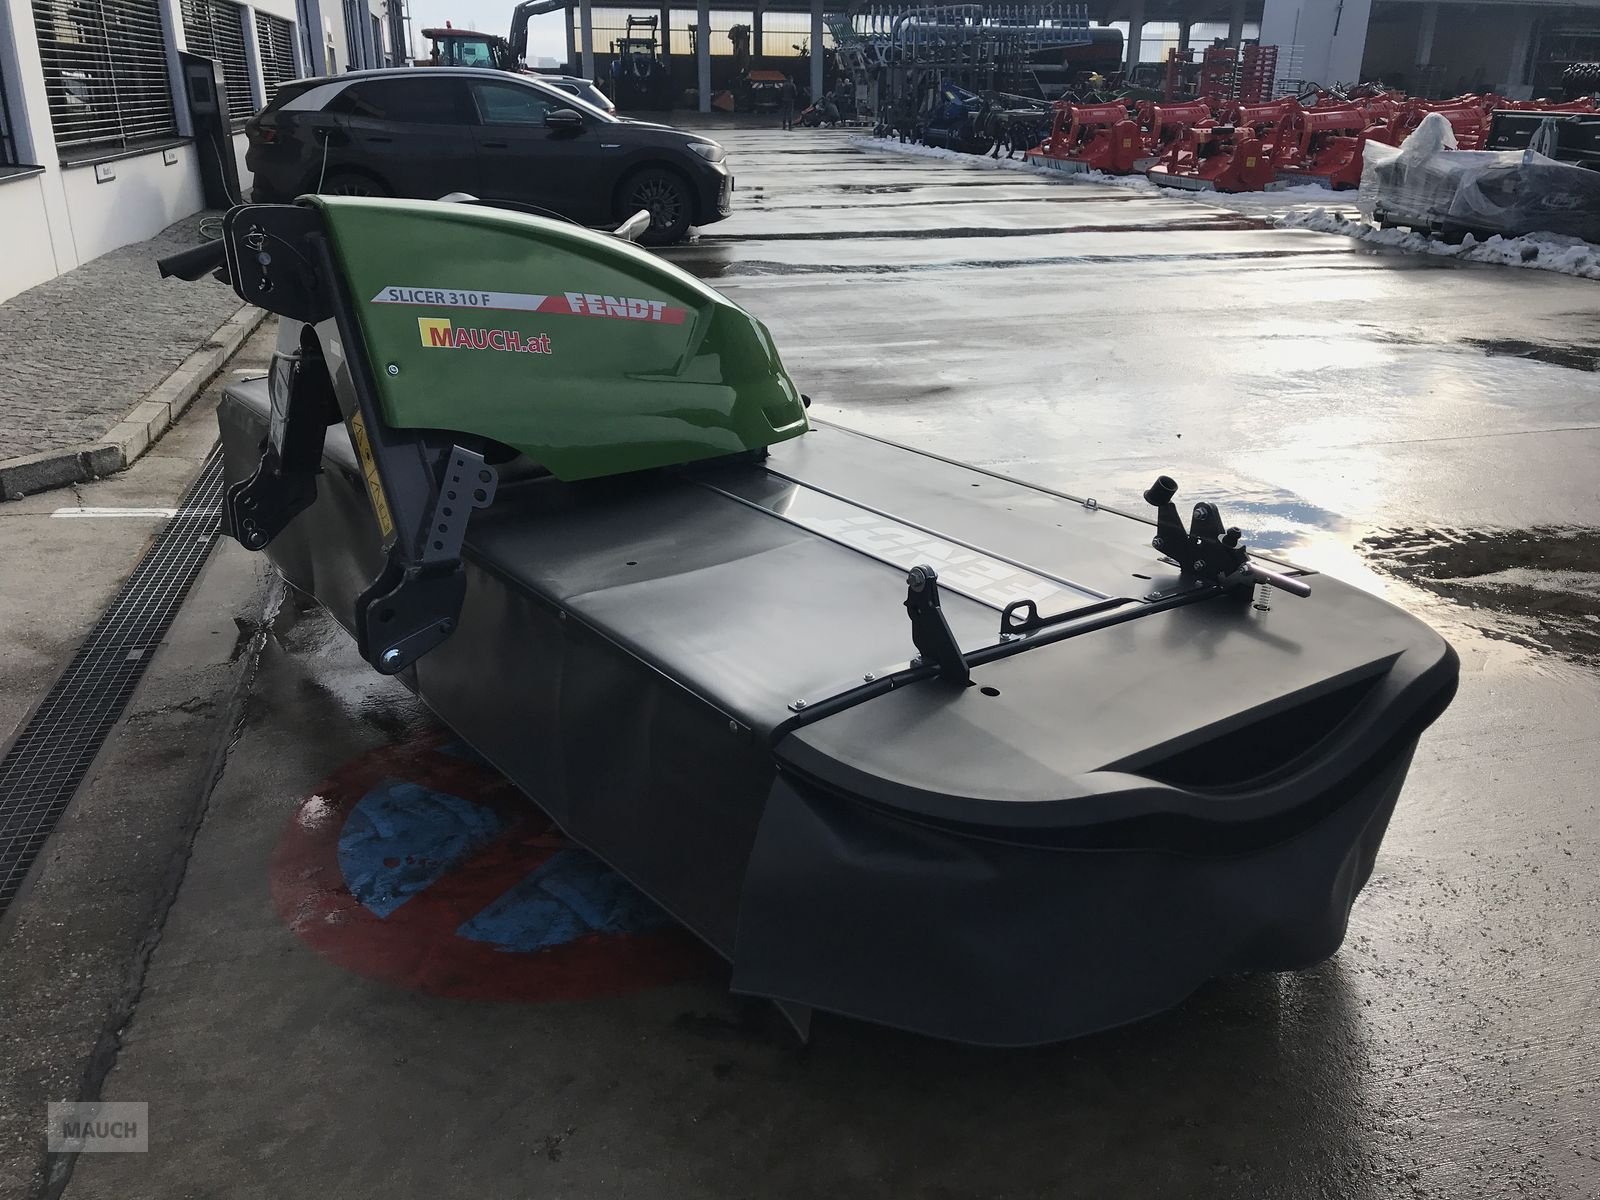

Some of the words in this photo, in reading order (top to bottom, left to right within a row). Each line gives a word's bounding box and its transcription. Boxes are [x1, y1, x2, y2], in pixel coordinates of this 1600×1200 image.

[389, 289, 444, 305] SLICER
[450, 292, 478, 306] 310
[481, 294, 490, 306] F
[564, 292, 667, 321] FENDT
[429, 326, 552, 354] MAUCH.at
